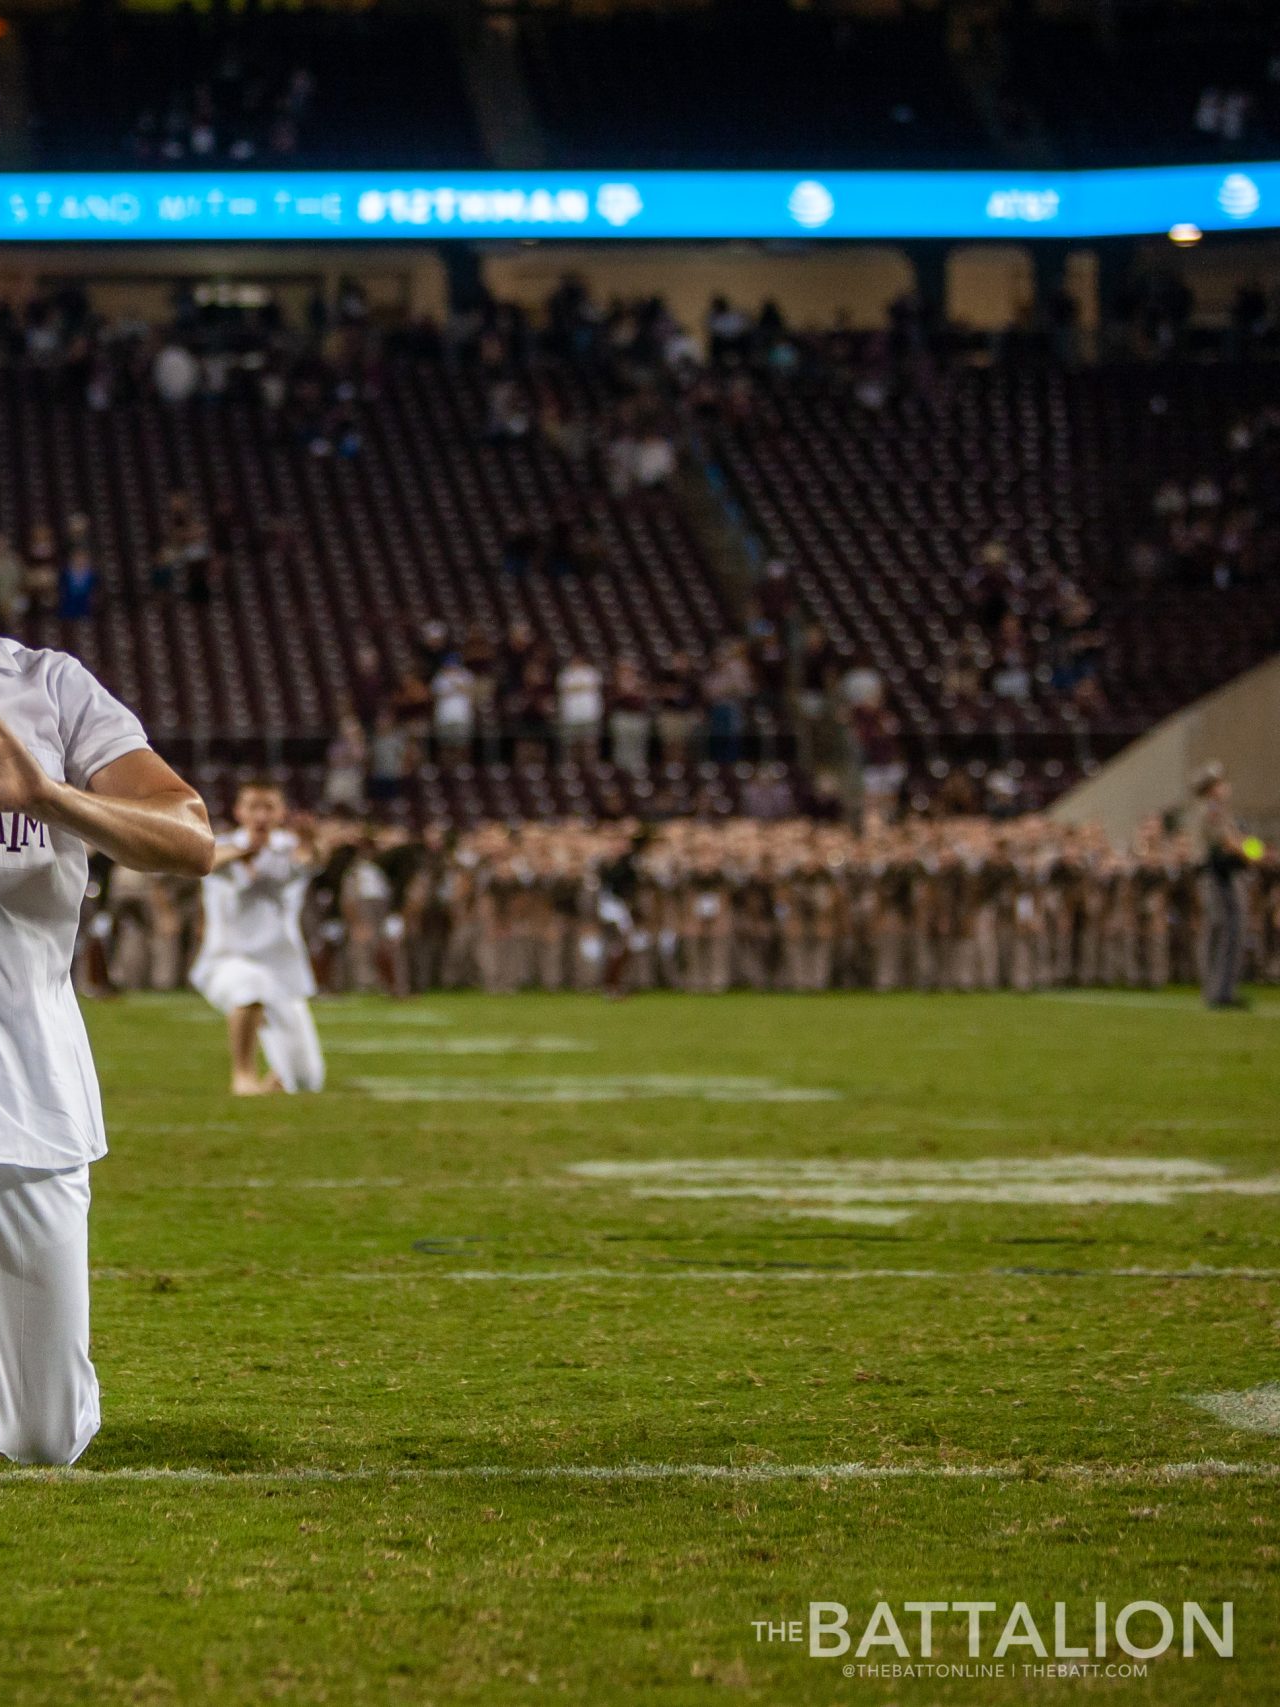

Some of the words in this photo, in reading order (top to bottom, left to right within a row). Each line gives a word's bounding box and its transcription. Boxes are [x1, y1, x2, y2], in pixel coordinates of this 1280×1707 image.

[9, 192, 140, 225] STAND
[158, 188, 257, 222] WITH
[275, 190, 342, 225] THE
